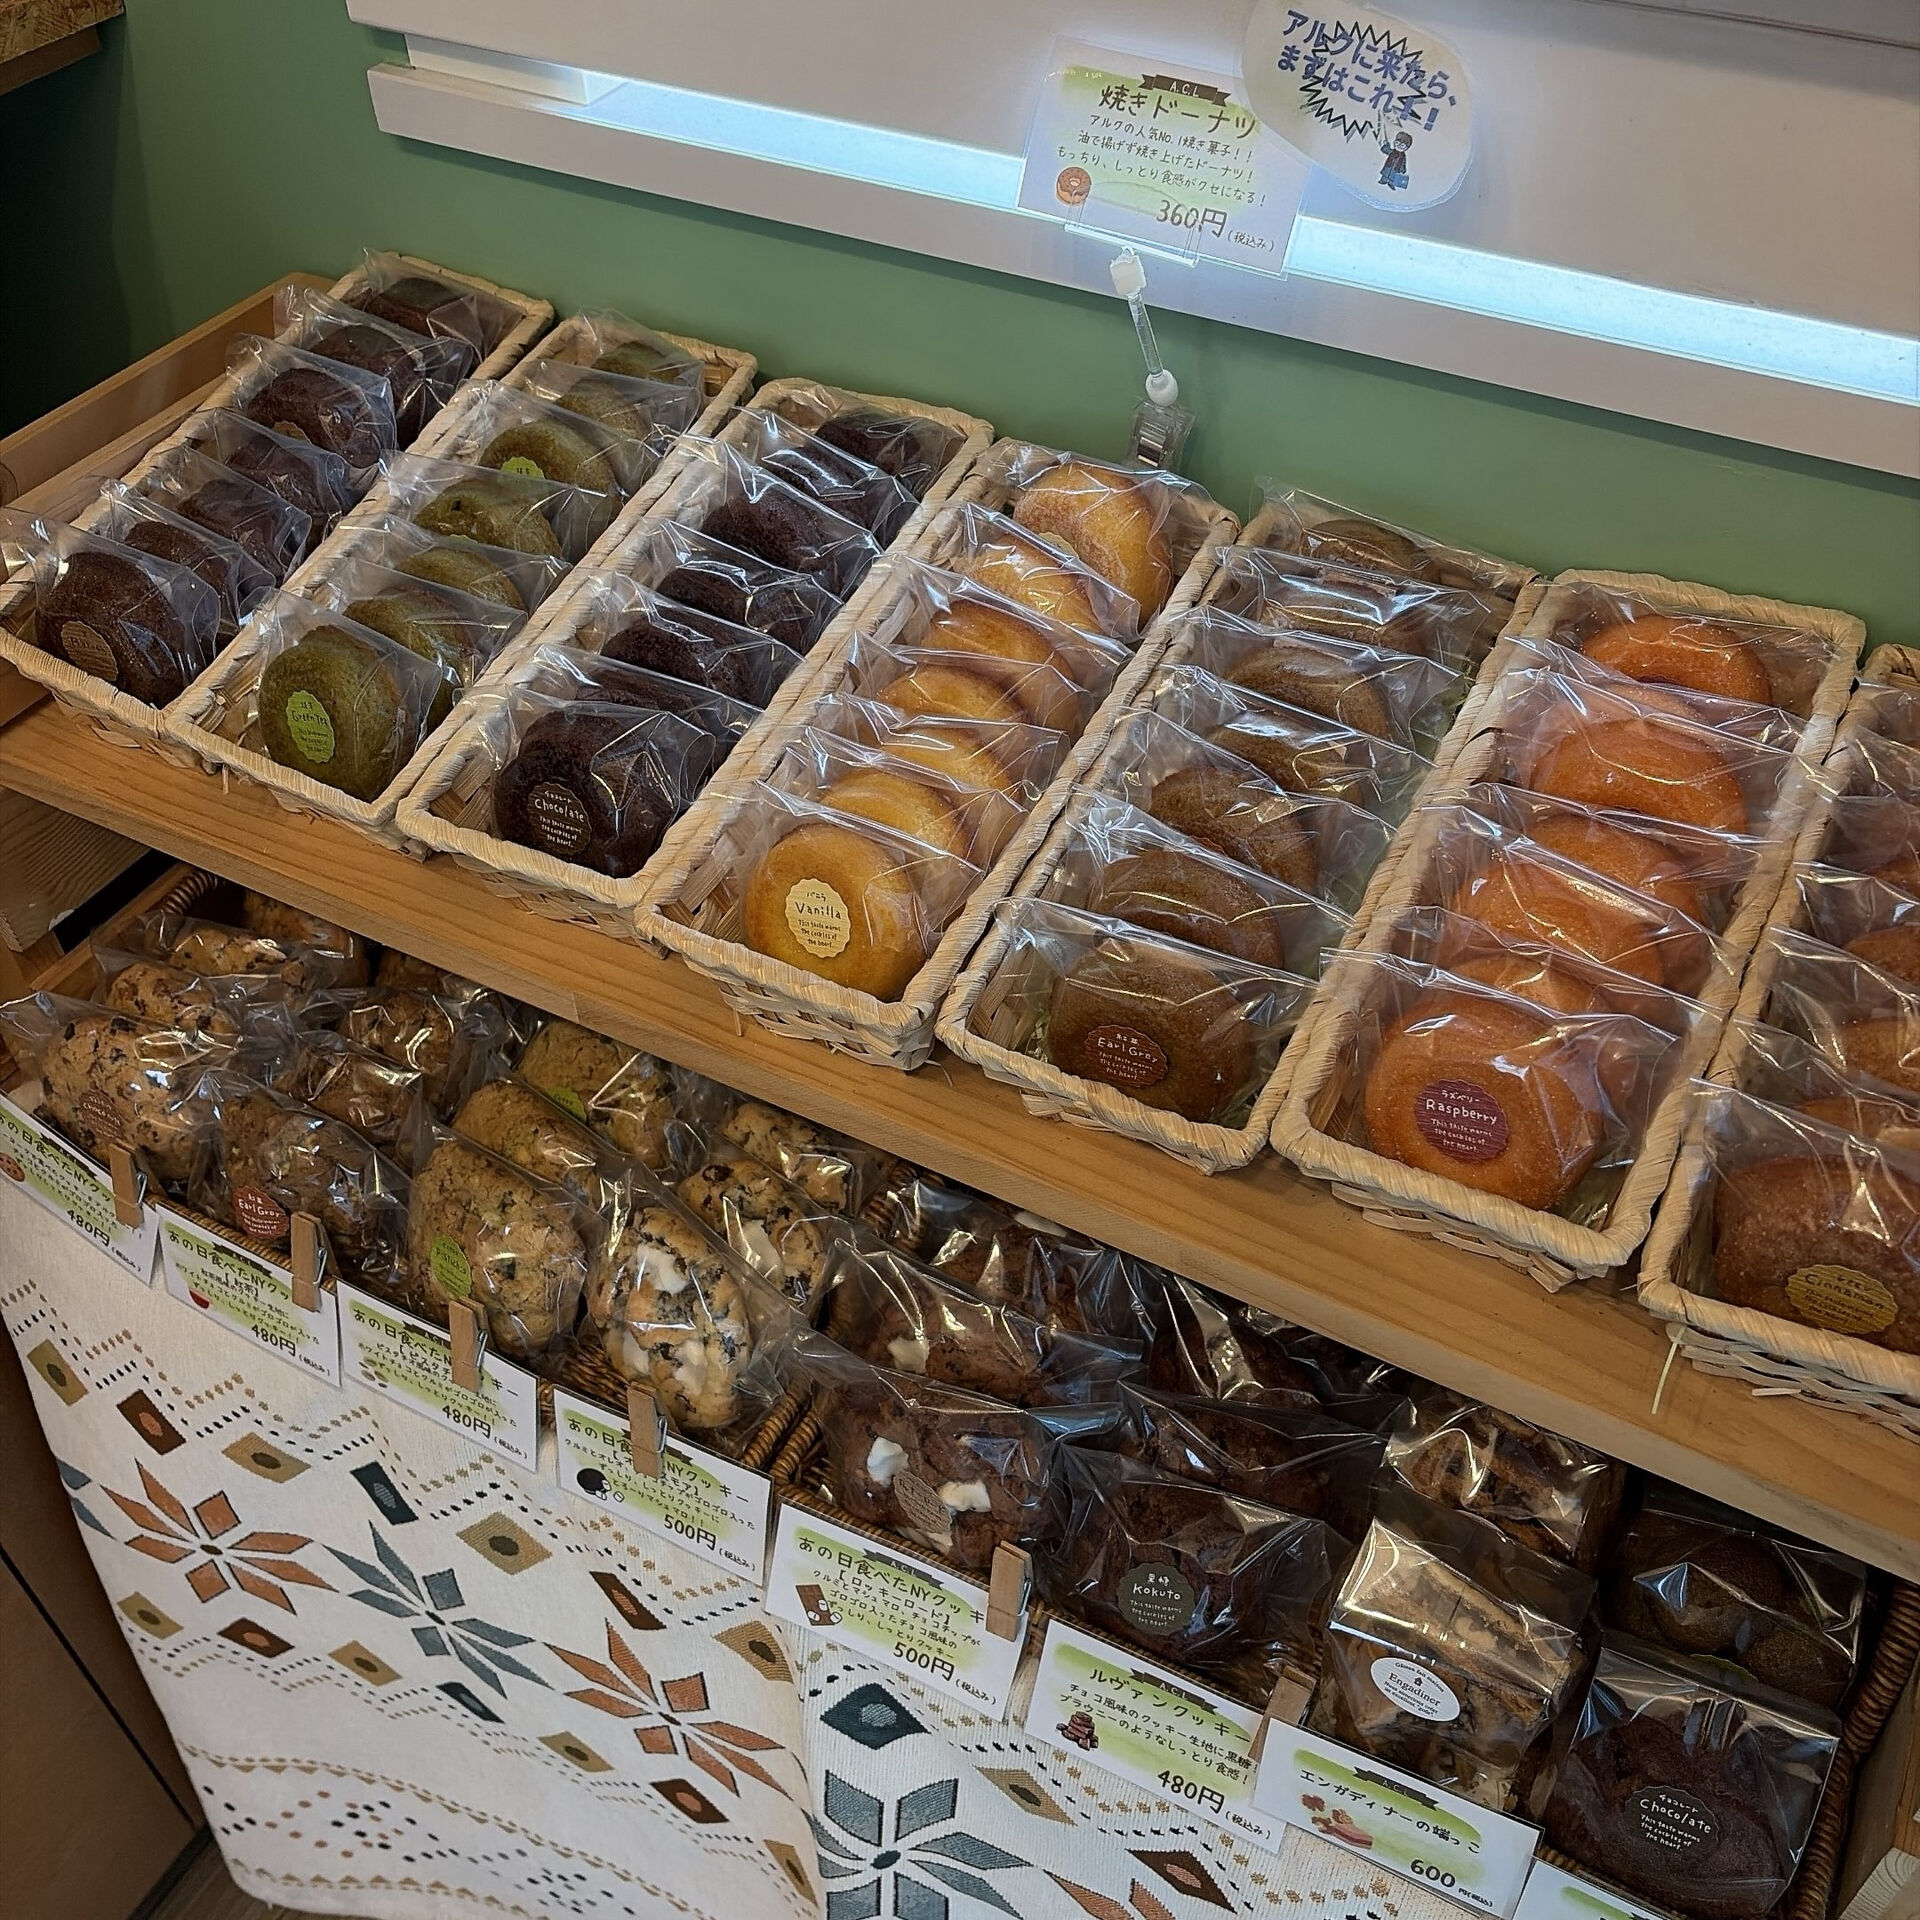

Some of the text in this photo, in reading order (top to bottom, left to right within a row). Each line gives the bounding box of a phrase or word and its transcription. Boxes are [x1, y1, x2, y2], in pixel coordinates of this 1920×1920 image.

[1099, 84, 1256, 140] 焼きドーナツ
[1156, 200, 1228, 238] 360円
[534, 798, 585, 822] Chocolate
[795, 901, 841, 919] Vanilla
[1097, 1036, 1158, 1063] Earl Grey
[1426, 1098, 1497, 1125] Raspberry
[238, 1198, 280, 1218] Earl Grey
[67, 1209, 110, 1247] 480円
[1805, 1273, 1884, 1309] Cinnamon
[251, 1324, 296, 1357] 480円
[442, 1405, 491, 1439] 480円
[664, 1515, 716, 1550] 500円
[1132, 1583, 1181, 1600] Kokuto
[893, 1642, 955, 1682] 500円
[1090, 1669, 1251, 1743] ルヴァンクッキー
[1388, 1672, 1441, 1707] Engadiner
[1158, 1770, 1225, 1814] 480円
[1300, 1768, 1481, 1855] エンガディナーの端っこ
[1640, 1799, 1711, 1834] Chocolate
[1410, 1858, 1456, 1888] 600
